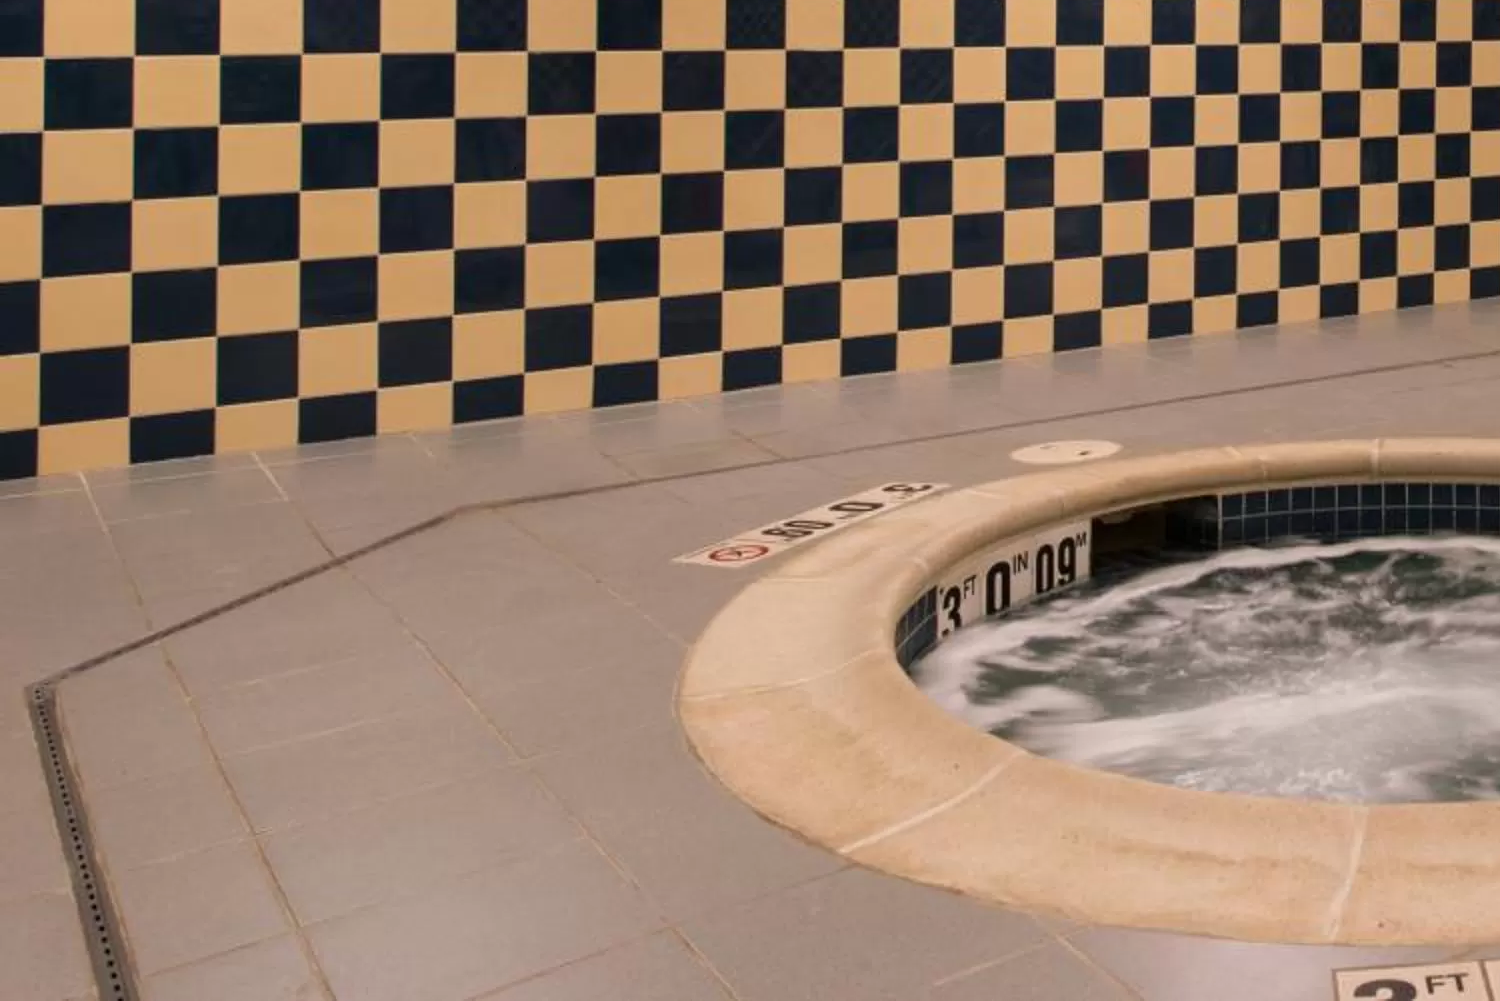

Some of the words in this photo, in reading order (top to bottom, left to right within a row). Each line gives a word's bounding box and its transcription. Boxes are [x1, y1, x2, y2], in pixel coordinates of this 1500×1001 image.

[942, 585, 962, 637] 3
[963, 575, 977, 599] FT
[986, 561, 1011, 615] 0
[1013, 551, 1029, 575] IN
[1075, 531, 1087, 548] M
[1425, 973, 1469, 994] FT
